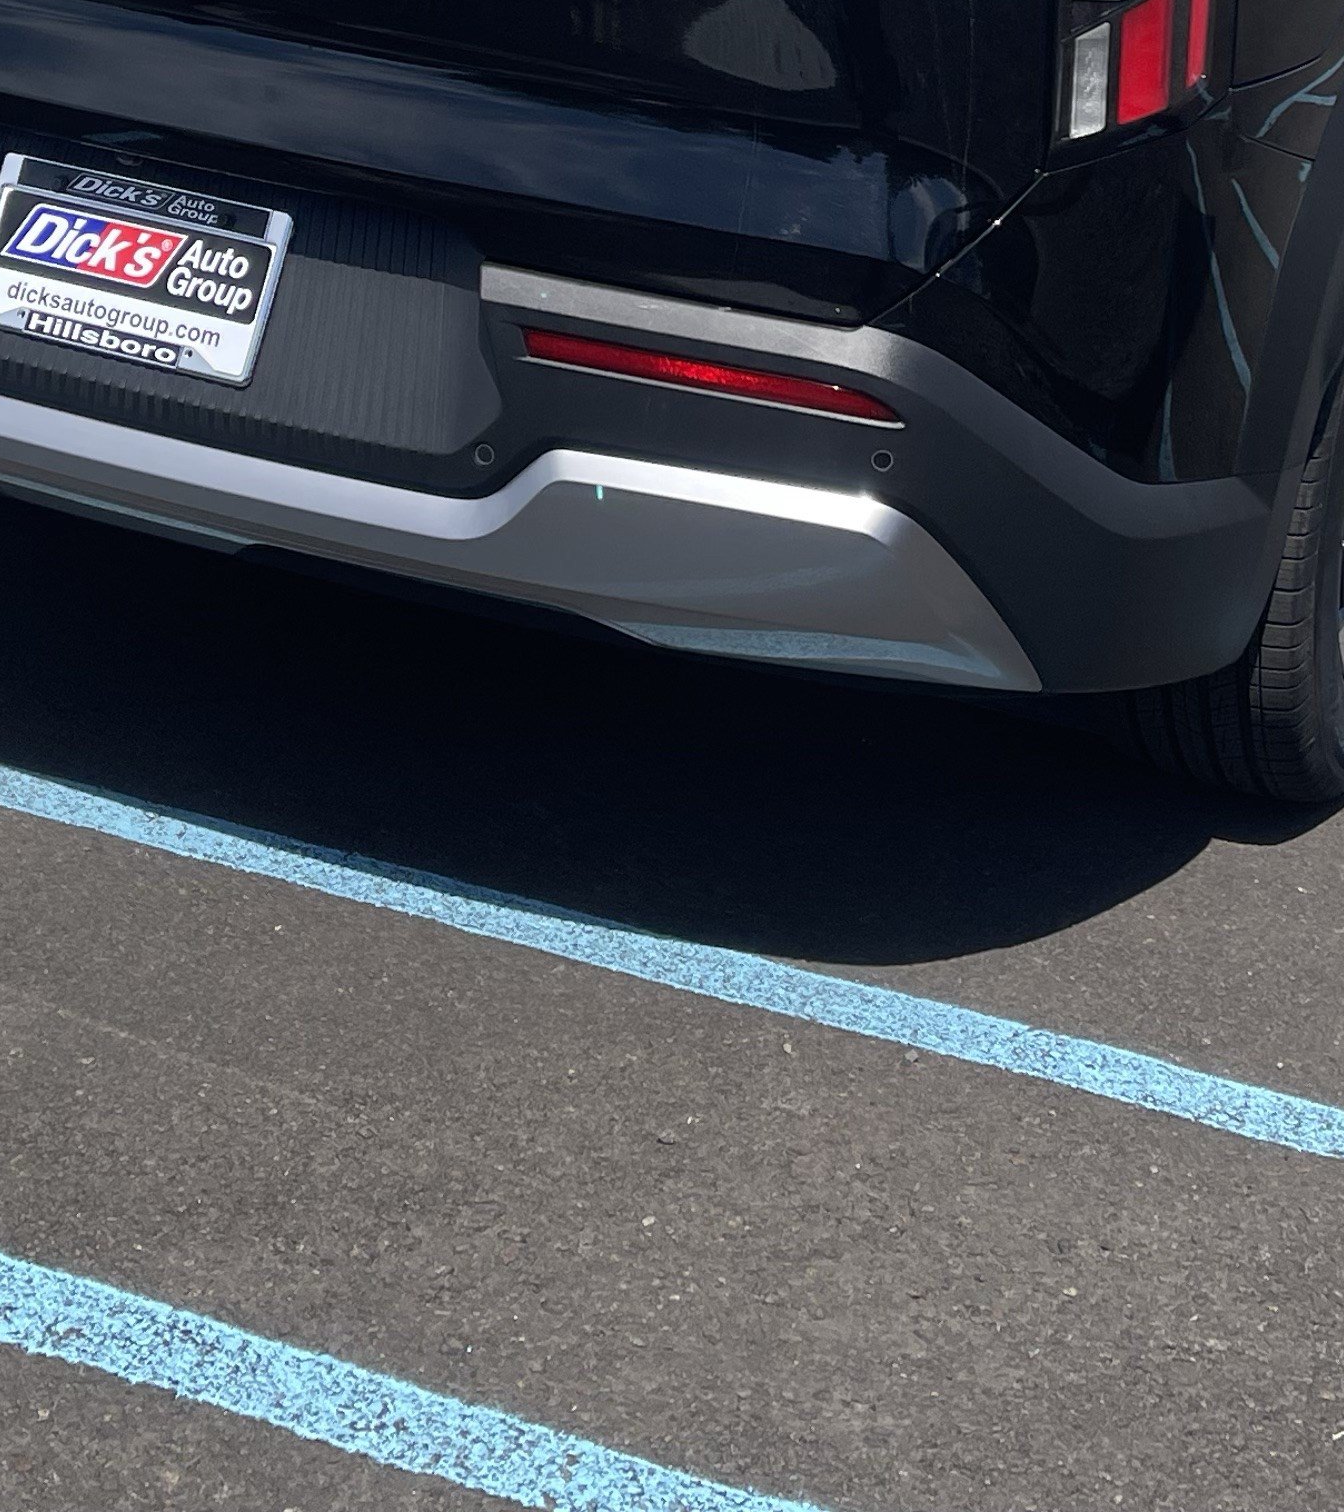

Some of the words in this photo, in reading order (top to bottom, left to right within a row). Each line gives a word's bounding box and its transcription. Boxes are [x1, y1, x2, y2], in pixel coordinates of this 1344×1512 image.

[73, 176, 163, 207] Dick's
[175, 195, 215, 212] Auto
[167, 204, 219, 224] Group
[16, 213, 162, 279] Dick's
[177, 240, 250, 279] Auto
[7, 281, 221, 348] dicksautogroup.com
[166, 266, 254, 314] Group
[28, 312, 177, 363] Hillsboro
